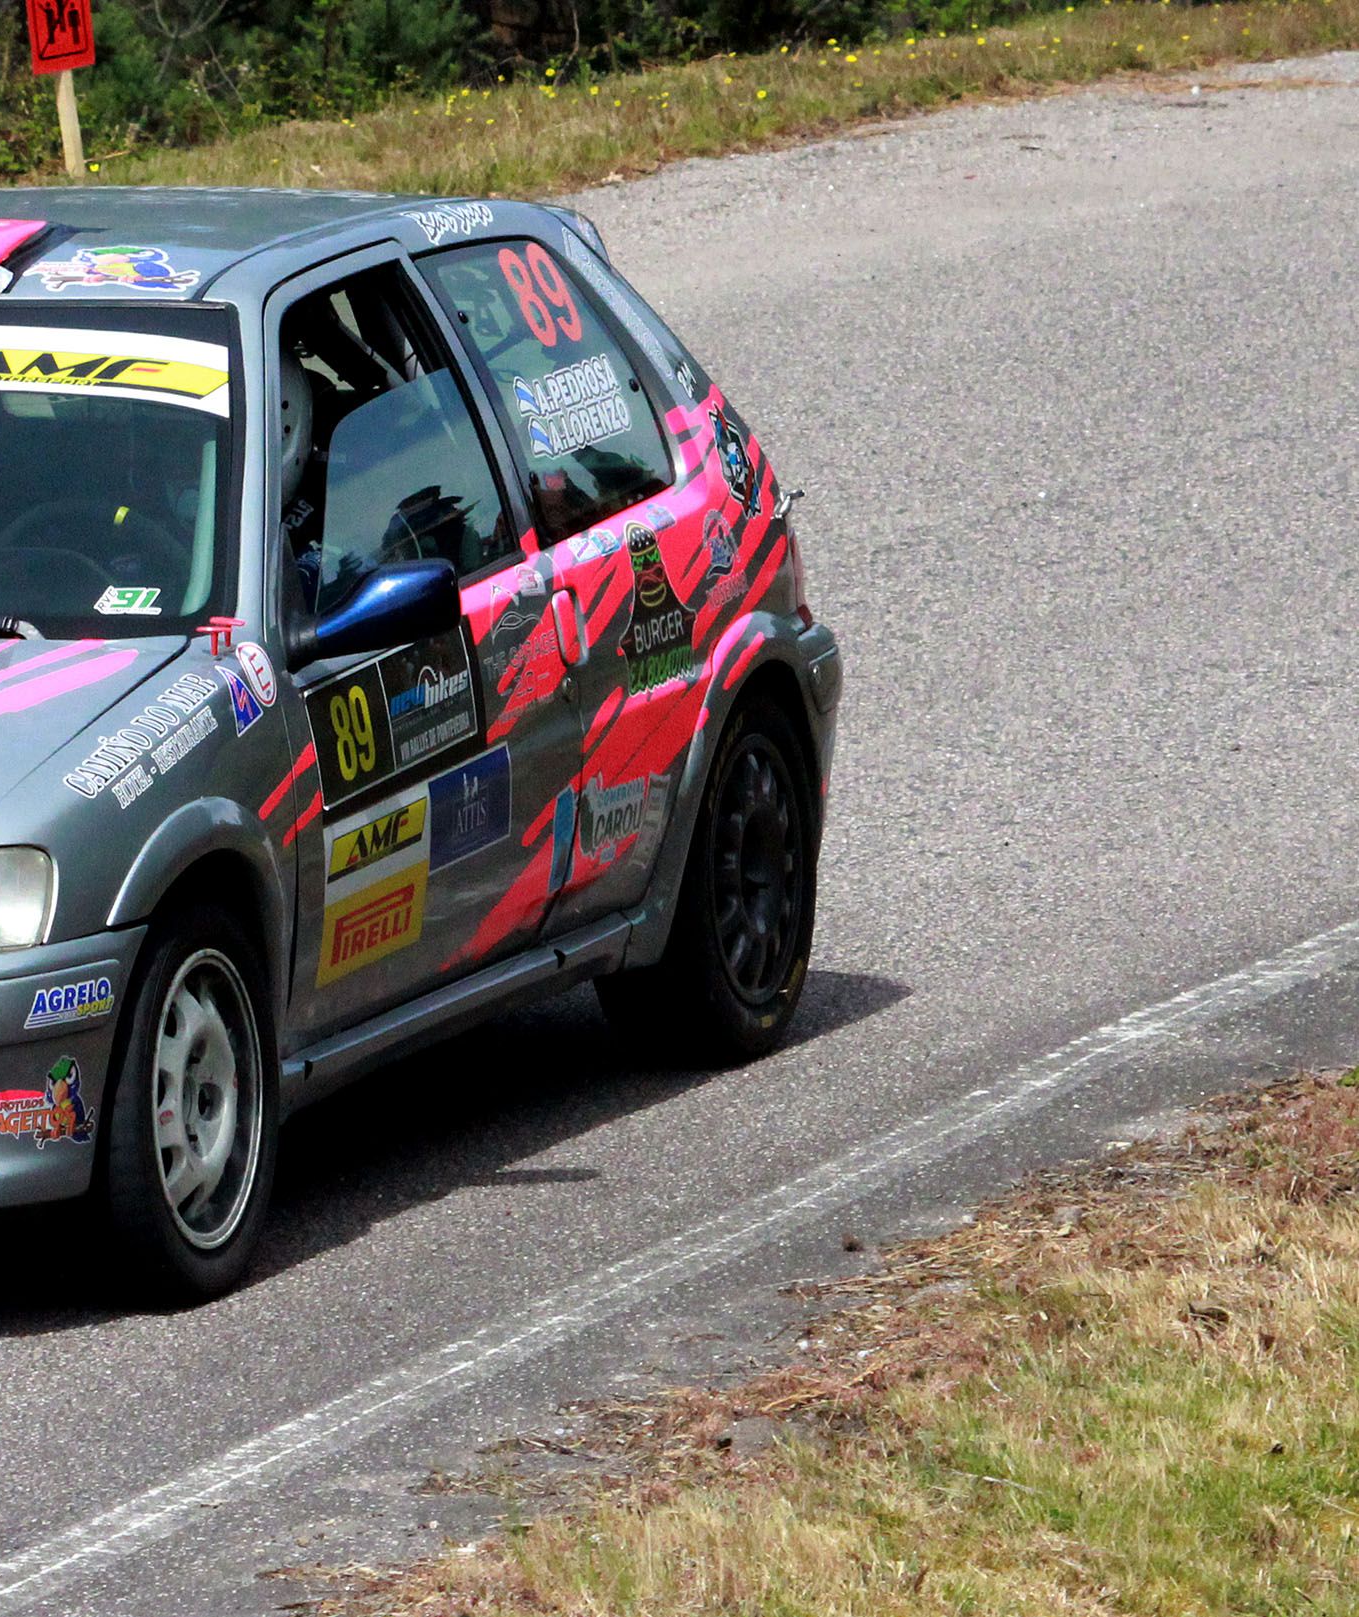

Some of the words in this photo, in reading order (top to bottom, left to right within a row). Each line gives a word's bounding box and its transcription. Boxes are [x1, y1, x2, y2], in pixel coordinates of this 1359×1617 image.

[498, 243, 582, 346] 89
[110, 590, 158, 608] 91
[634, 610, 683, 653] BURGER
[131, 706, 180, 737] DO
[158, 674, 217, 714] MAR
[329, 685, 375, 781] 89
[112, 765, 153, 809] HOTEL
[152, 706, 218, 774] RESTAURANTE
[346, 808, 409, 867] AMF
[330, 883, 415, 967] PIRELLI
[33, 979, 110, 1015] AGRELO
